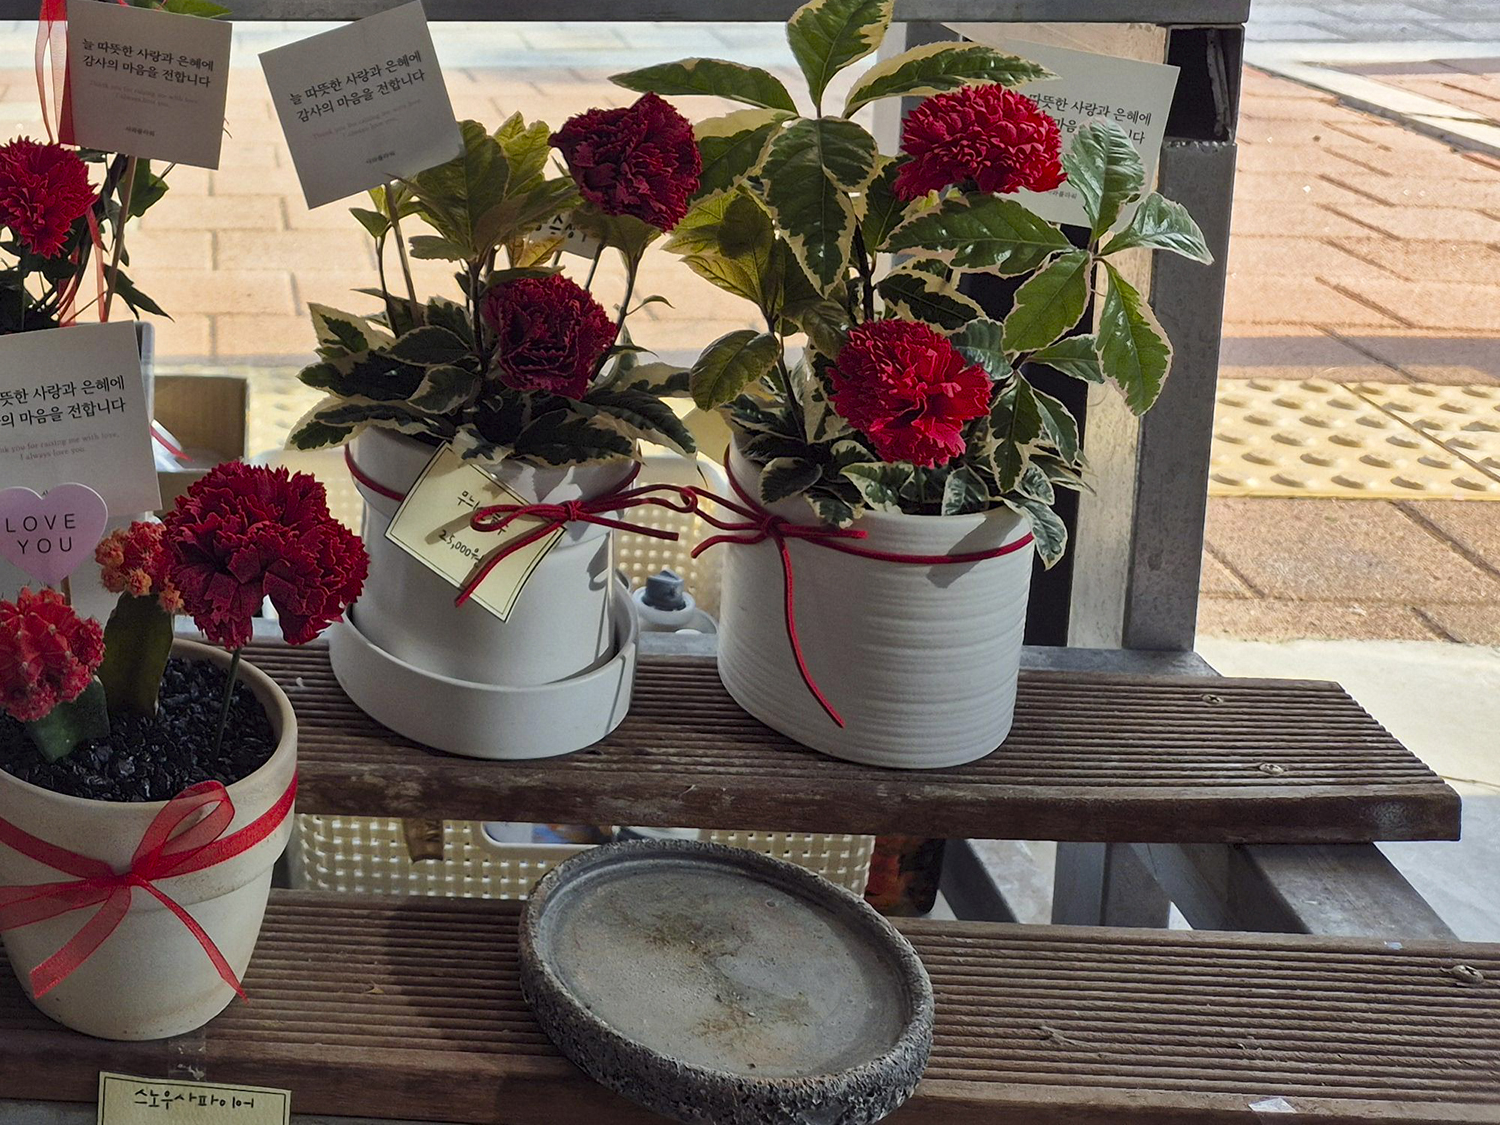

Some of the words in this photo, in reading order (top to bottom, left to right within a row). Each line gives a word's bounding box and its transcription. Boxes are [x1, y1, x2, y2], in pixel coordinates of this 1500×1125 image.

[82, 39, 94, 51] 늘
[97, 41, 134, 57] 따뜻한
[136, 48, 174, 65] 사랑과
[177, 55, 214, 71] 은혜에
[83, 55, 119, 71] 감사의
[122, 62, 158, 78] 마음을
[162, 69, 212, 88] 전합니다
[289, 92, 302, 106] 늘
[304, 78, 343, 99] 따뜻한
[346, 66, 382, 87] 사랑과
[385, 51, 422, 75] 은혜에
[296, 100, 335, 123] 감사의
[337, 87, 374, 109] 마음을
[376, 69, 426, 95] 전합니다
[1070, 99, 1111, 118] 사랑과
[1113, 107, 1152, 127] 은혜에
[32, 381, 77, 401] 사랑과
[80, 375, 125, 396] 은혜에
[20, 405, 64, 427] 마음을
[68, 397, 126, 420] 전합니다
[12, 445, 26, 455] you
[28, 441, 38, 451] for
[82, 433, 100, 443] with
[26, 451, 52, 462] always
[53, 449, 68, 458] love
[5, 513, 76, 533] LOVE
[18, 537, 72, 555] YOU
[134, 1089, 255, 1110] 스노우사파이어
